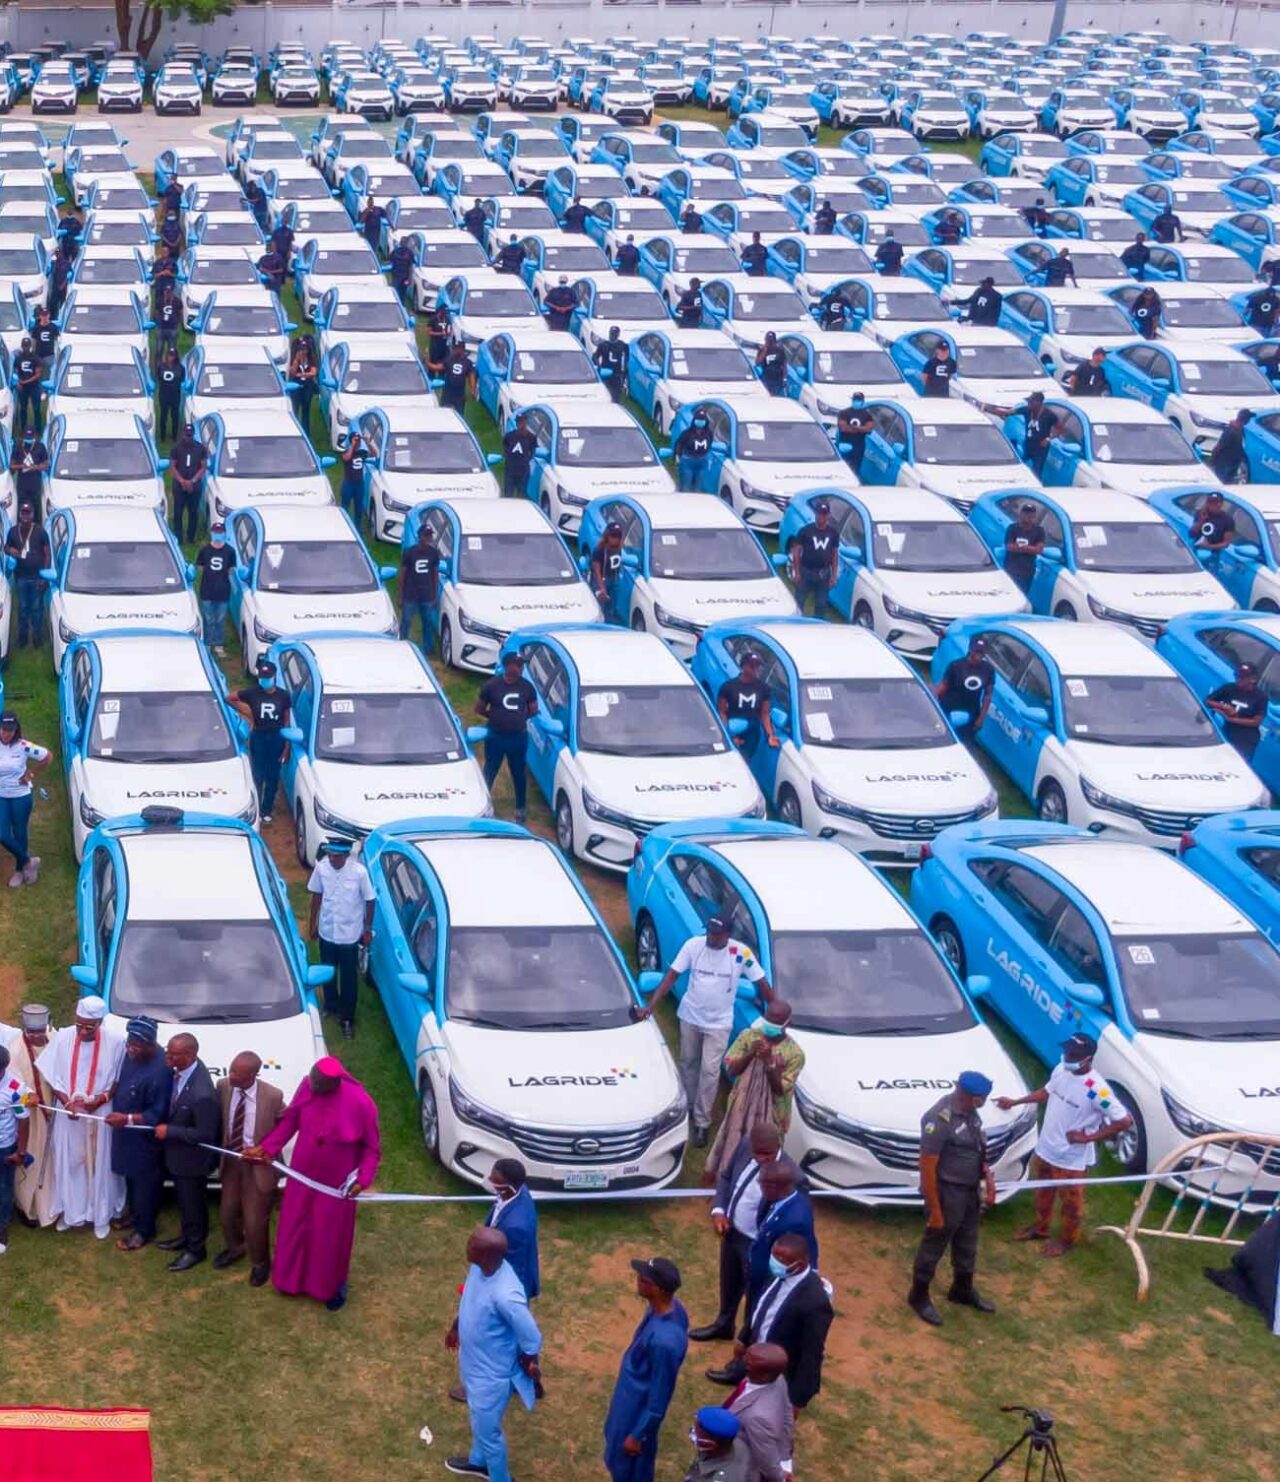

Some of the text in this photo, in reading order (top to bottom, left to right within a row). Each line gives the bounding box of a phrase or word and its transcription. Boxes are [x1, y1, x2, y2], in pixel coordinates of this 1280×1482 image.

[1137, 308, 1148, 317] O
[1260, 302, 1271, 312] O
[40, 331, 50, 341] E
[609, 352, 618, 362] L
[20, 361, 33, 372] E
[452, 363, 463, 374] S
[936, 365, 947, 377] E
[163, 371, 174, 380] D
[511, 442, 523, 454] A
[694, 439, 707, 450] M
[352, 458, 363, 469] S
[1201, 522, 1214, 535] O
[812, 536, 829, 550] W
[210, 556, 223, 570] S
[415, 559, 429, 573] E
[610, 555, 621, 569] D
[964, 676, 982, 690] O
[503, 693, 519, 709] C
[738, 692, 756, 708] M
[635, 783, 720, 792] LAGRIDE
[127, 790, 213, 798] LAGRIDE
[364, 792, 449, 800] LAGRIDE
[985, 936, 1063, 1025] LAGRIDE
[507, 1076, 616, 1087] LAGRIDE
